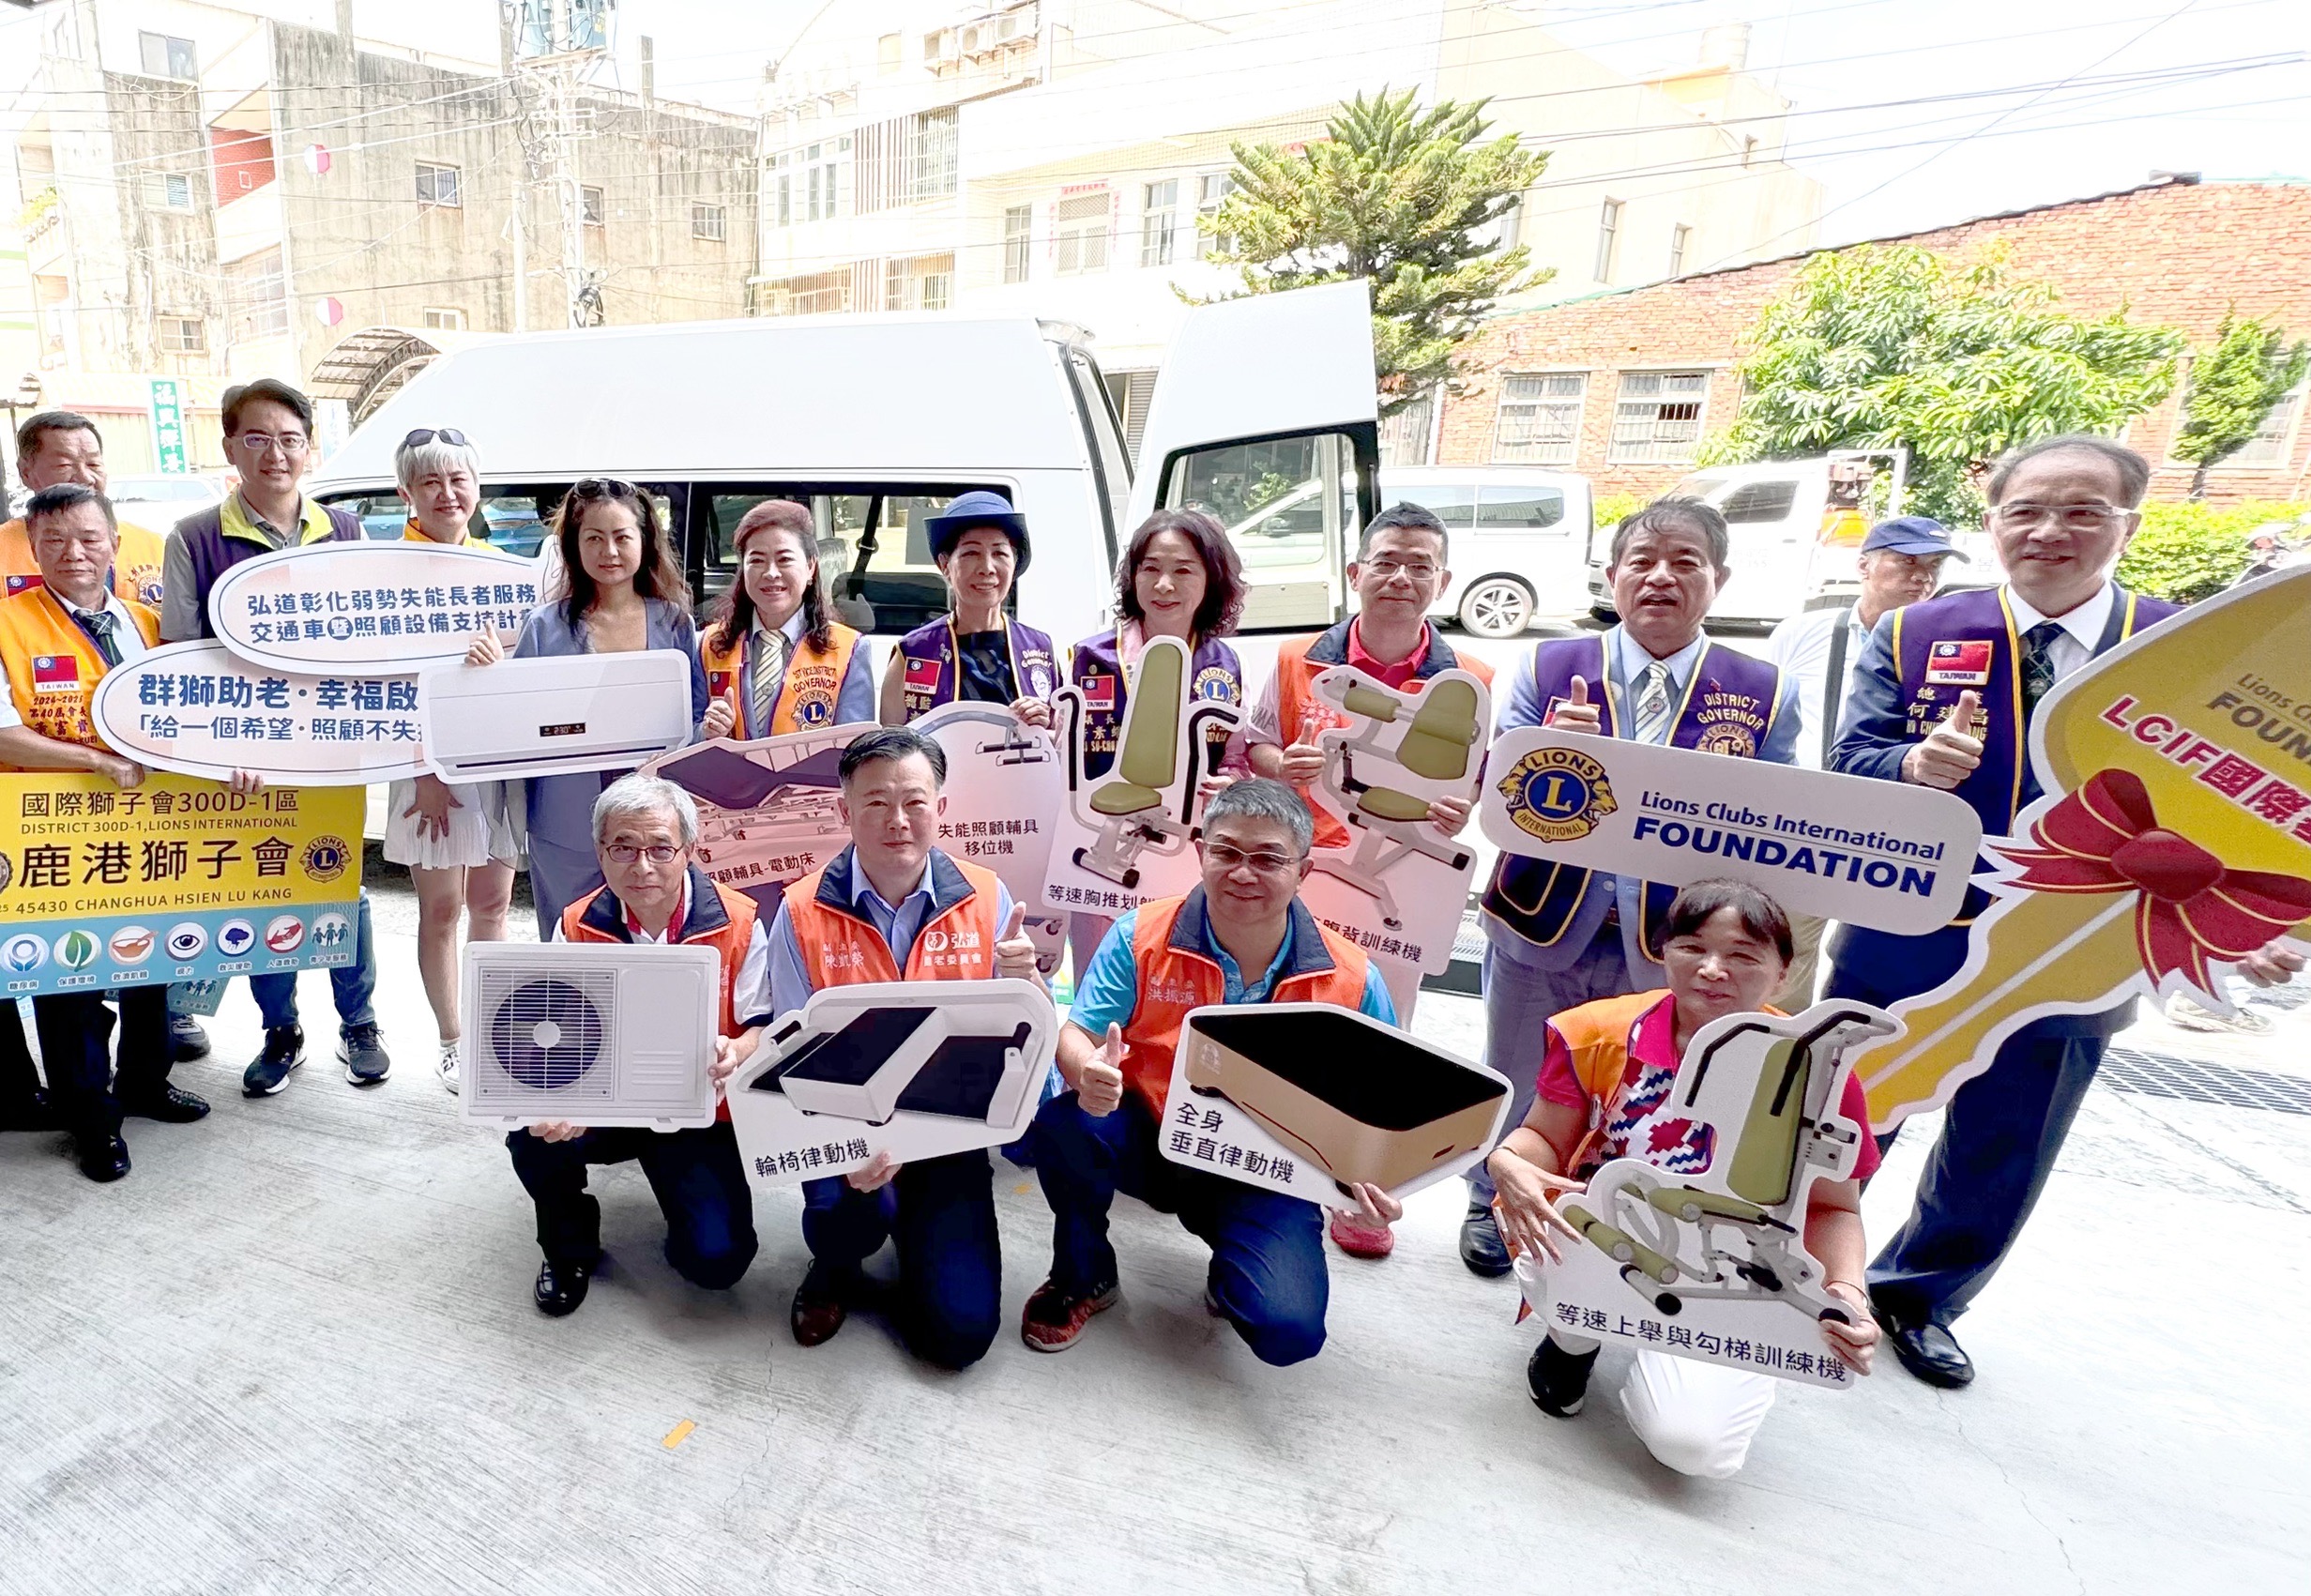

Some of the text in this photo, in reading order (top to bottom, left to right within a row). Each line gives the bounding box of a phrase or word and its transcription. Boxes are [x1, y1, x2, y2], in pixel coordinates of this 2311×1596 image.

[247, 584, 537, 616] 弘道彰化弱勢失能長者服務
[793, 677, 837, 692] GOVERNOR
[1704, 692, 1760, 711] DISTRICT
[1696, 707, 1765, 731] GOVERNOR
[1529, 751, 1599, 777] LIONS
[21, 789, 299, 819] 國際獅子會300D-1區
[1541, 775, 1573, 813] L
[21, 823, 90, 835] DISTRICT
[193, 816, 298, 830] INTERNATIONAL
[938, 818, 1040, 839] 失能照顧輔具
[1517, 813, 1584, 837] INTERNATIONAL
[1640, 790, 1945, 861] Lions Clubs International
[312, 838, 342, 849] LIONS
[965, 840, 1014, 856] 移位機
[1633, 815, 1938, 898] FOUNDATION
[19, 835, 295, 889] 鹿港獅子會
[320, 850, 333, 867] L
[16, 900, 68, 914] 45430
[75, 894, 167, 911] CHANGHUA
[175, 892, 222, 905] HSIEN
[228, 890, 246, 902] LU
[252, 888, 292, 901] KANG
[951, 932, 981, 949] 弘道
[1314, 916, 1422, 963] 腹背訓練機
[1175, 1102, 1224, 1133] 全身
[754, 1137, 871, 1178] 輪椅律動機
[1169, 1130, 1295, 1184] 垂直律動機
[1555, 1301, 1847, 1382] 等速上舉與勾梯訓練機
